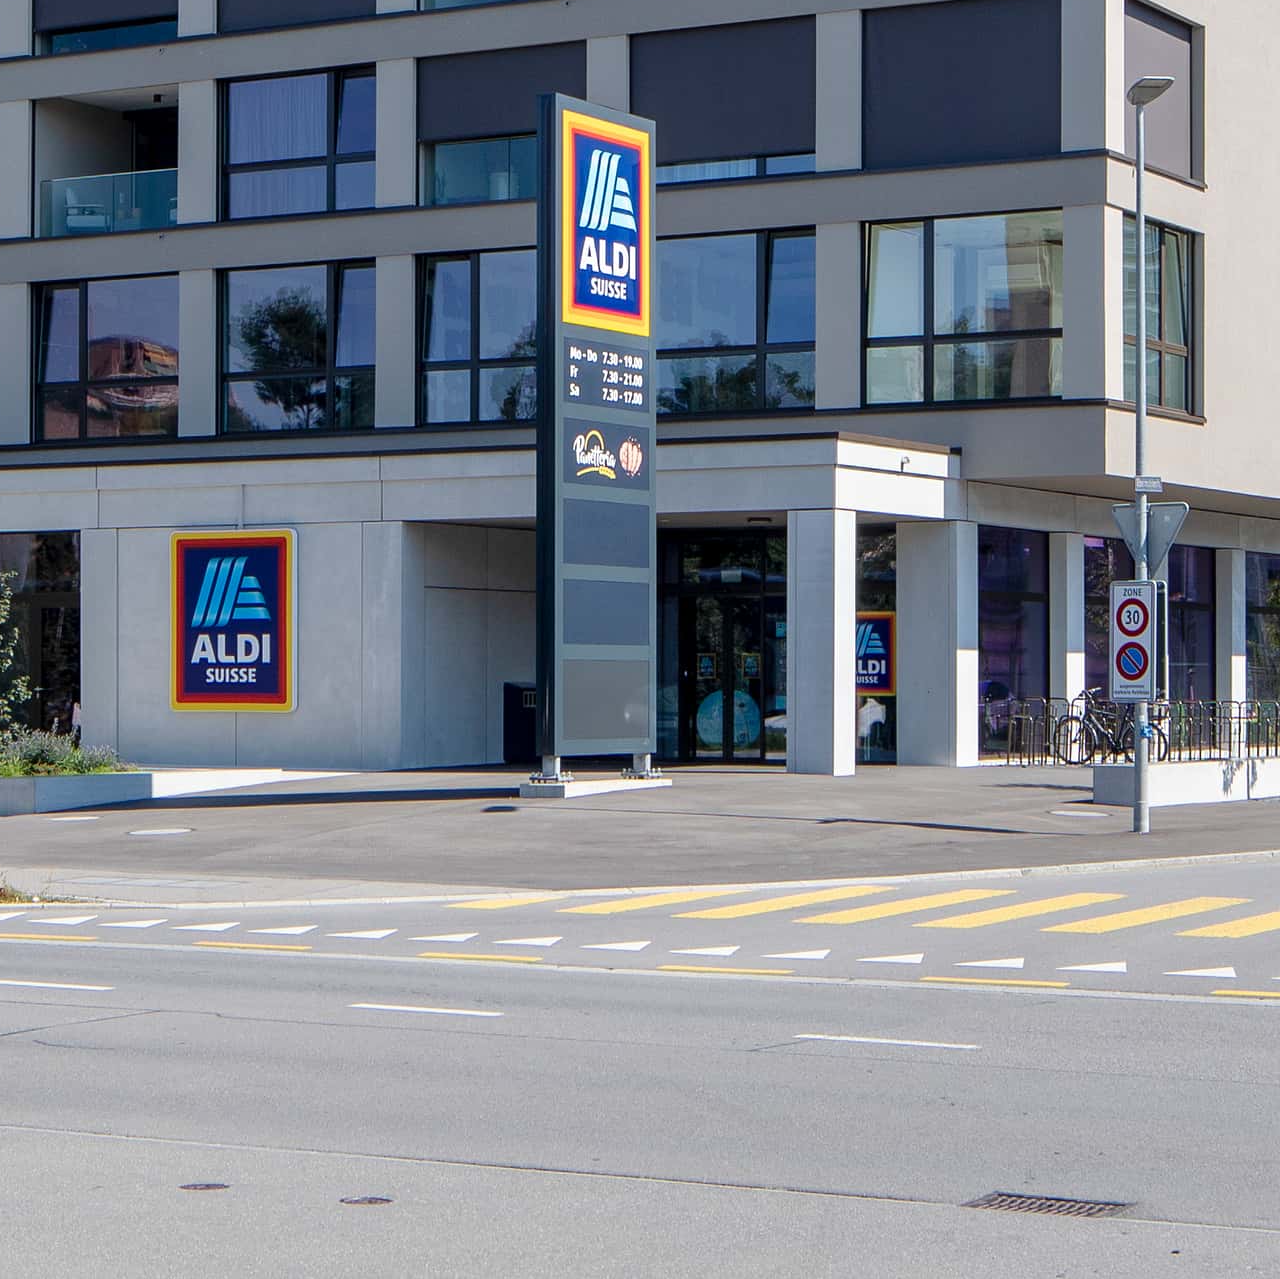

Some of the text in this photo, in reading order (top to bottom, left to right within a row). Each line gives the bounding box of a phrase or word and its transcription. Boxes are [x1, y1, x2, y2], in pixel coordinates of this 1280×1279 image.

[579, 235, 636, 280] ALDI
[590, 277, 627, 300] SUISSE
[602, 351, 619, 366] 7.30
[623, 355, 643, 370] 19.00
[569, 364, 579, 378] Fr
[602, 369, 619, 385] 7.30
[623, 372, 643, 388] 21.00
[569, 383, 580, 397] Sa
[602, 387, 619, 402] 7.30
[623, 390, 643, 406] 17.00
[573, 434, 617, 469] Panetteria
[1123, 587, 1142, 597] ZONE
[1124, 610, 1140, 625] 30
[191, 633, 271, 664] ALDI
[206, 668, 257, 683] SUISSE
[855, 658, 887, 675] LDI
[855, 674, 879, 684] UISSE
